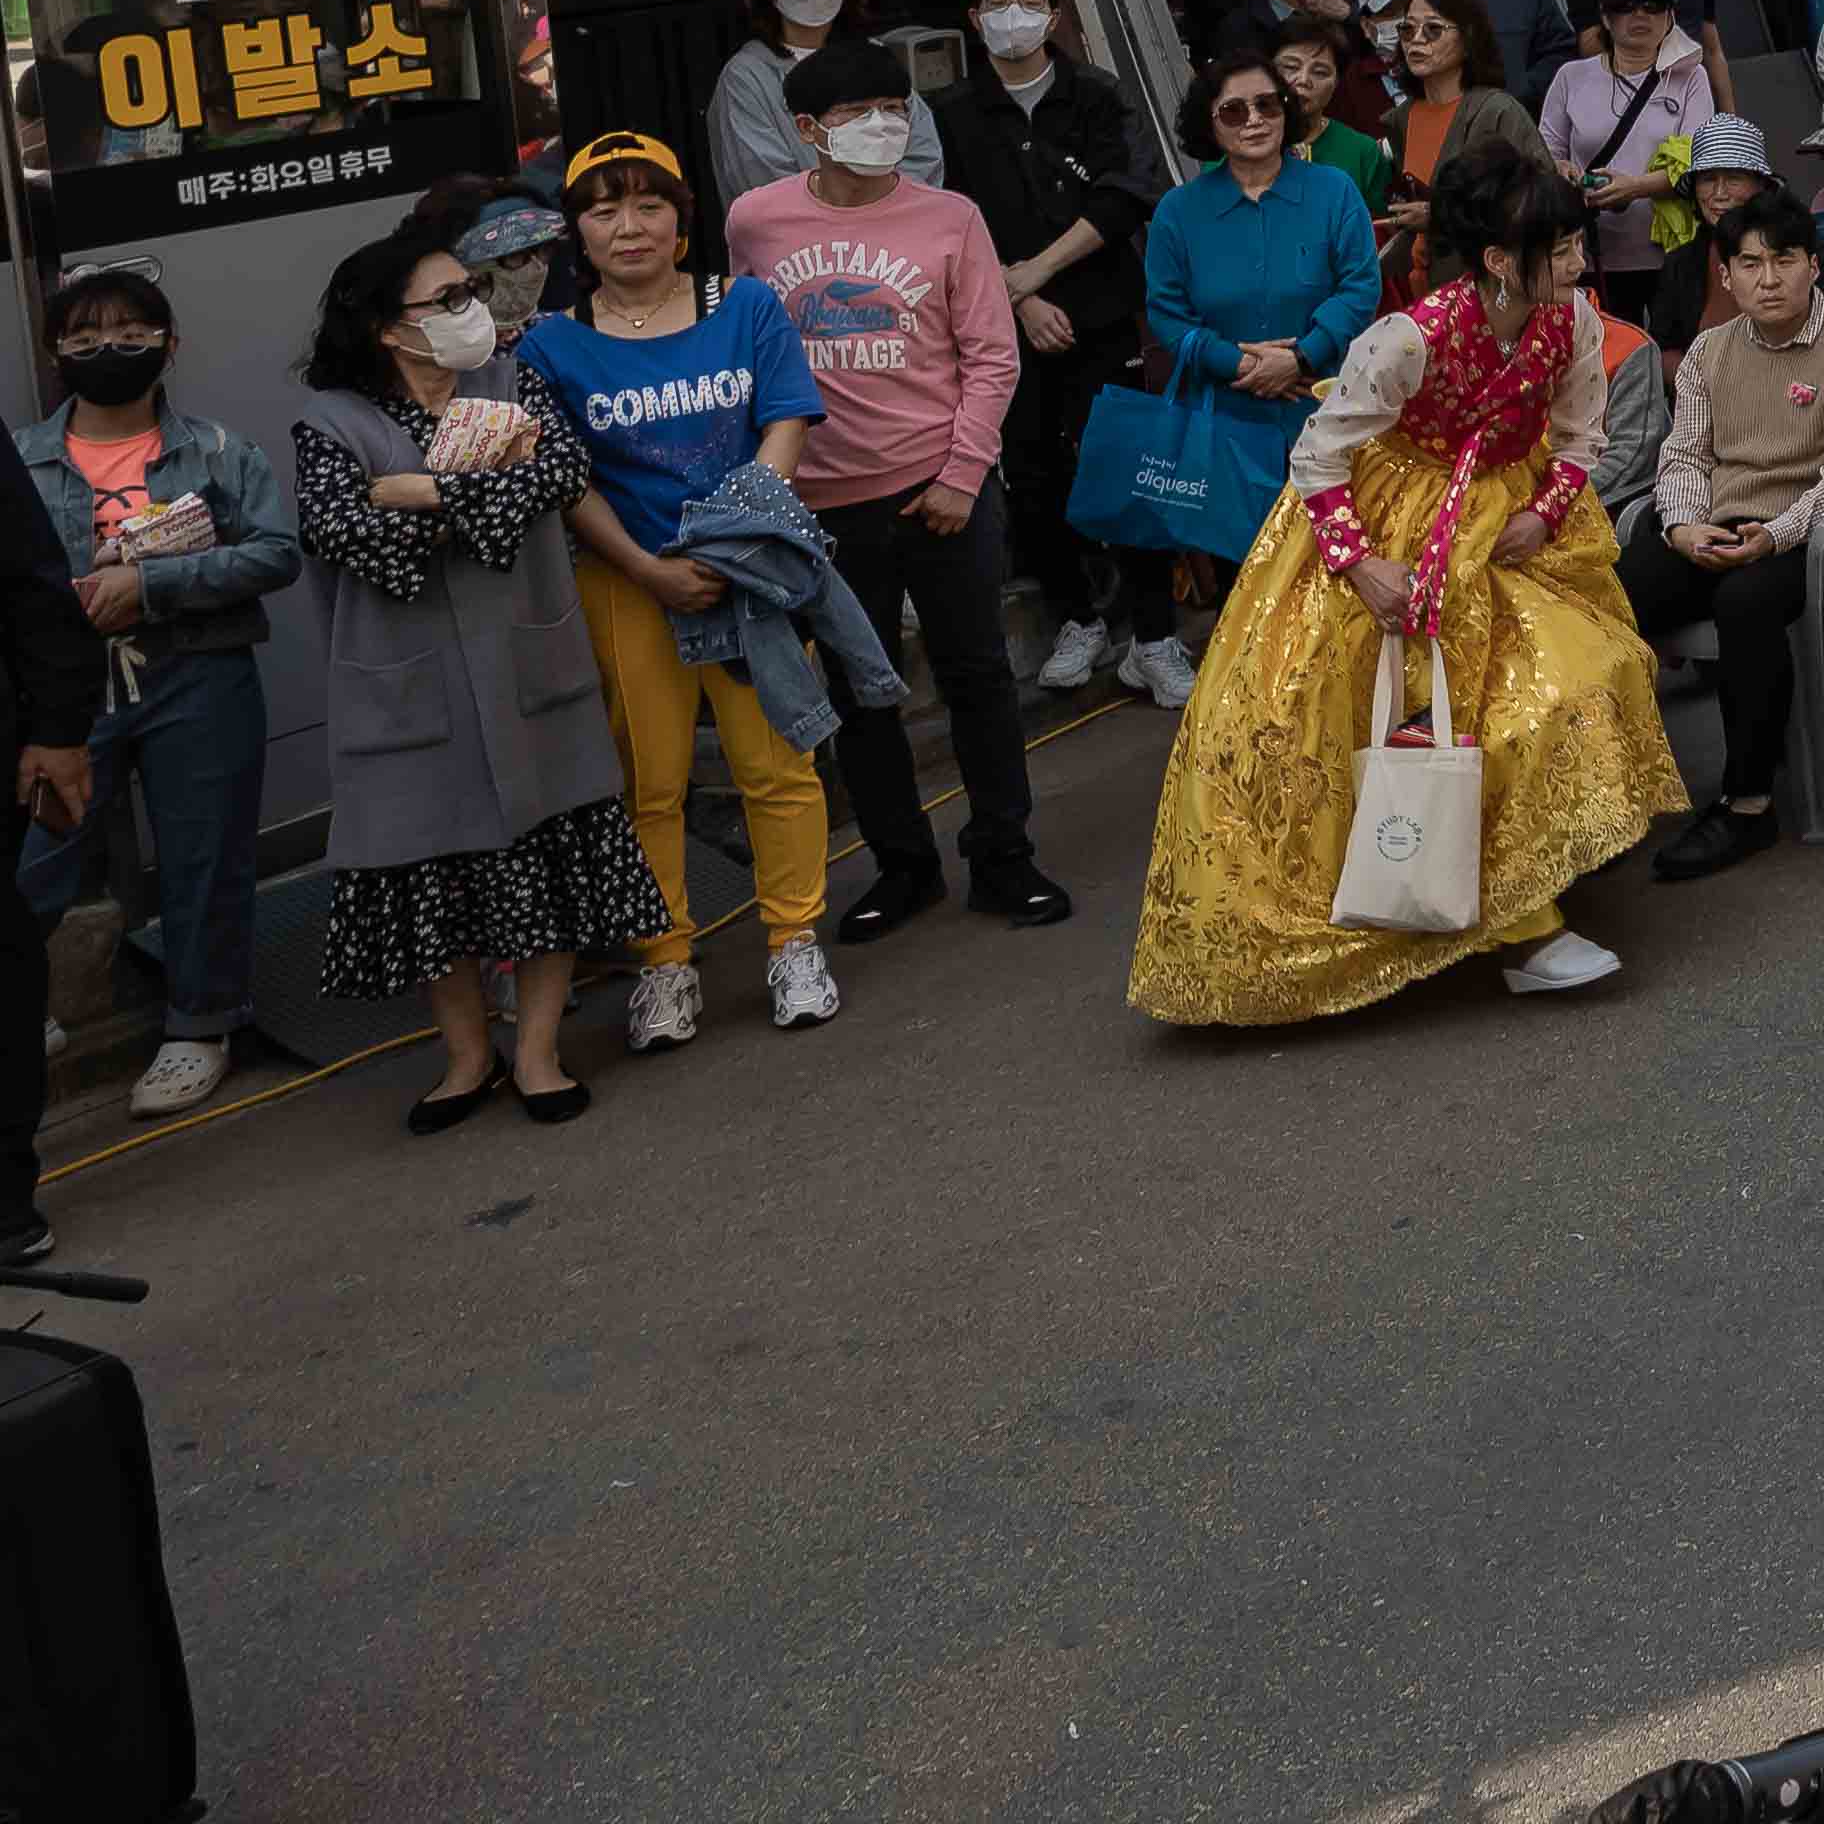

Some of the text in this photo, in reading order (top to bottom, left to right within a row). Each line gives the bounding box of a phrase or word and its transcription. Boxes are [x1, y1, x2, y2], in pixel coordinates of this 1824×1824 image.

[99, 3, 433, 129] 이발소
[338, 145, 393, 179] 휴무
[803, 339, 906, 370] INTAGE
